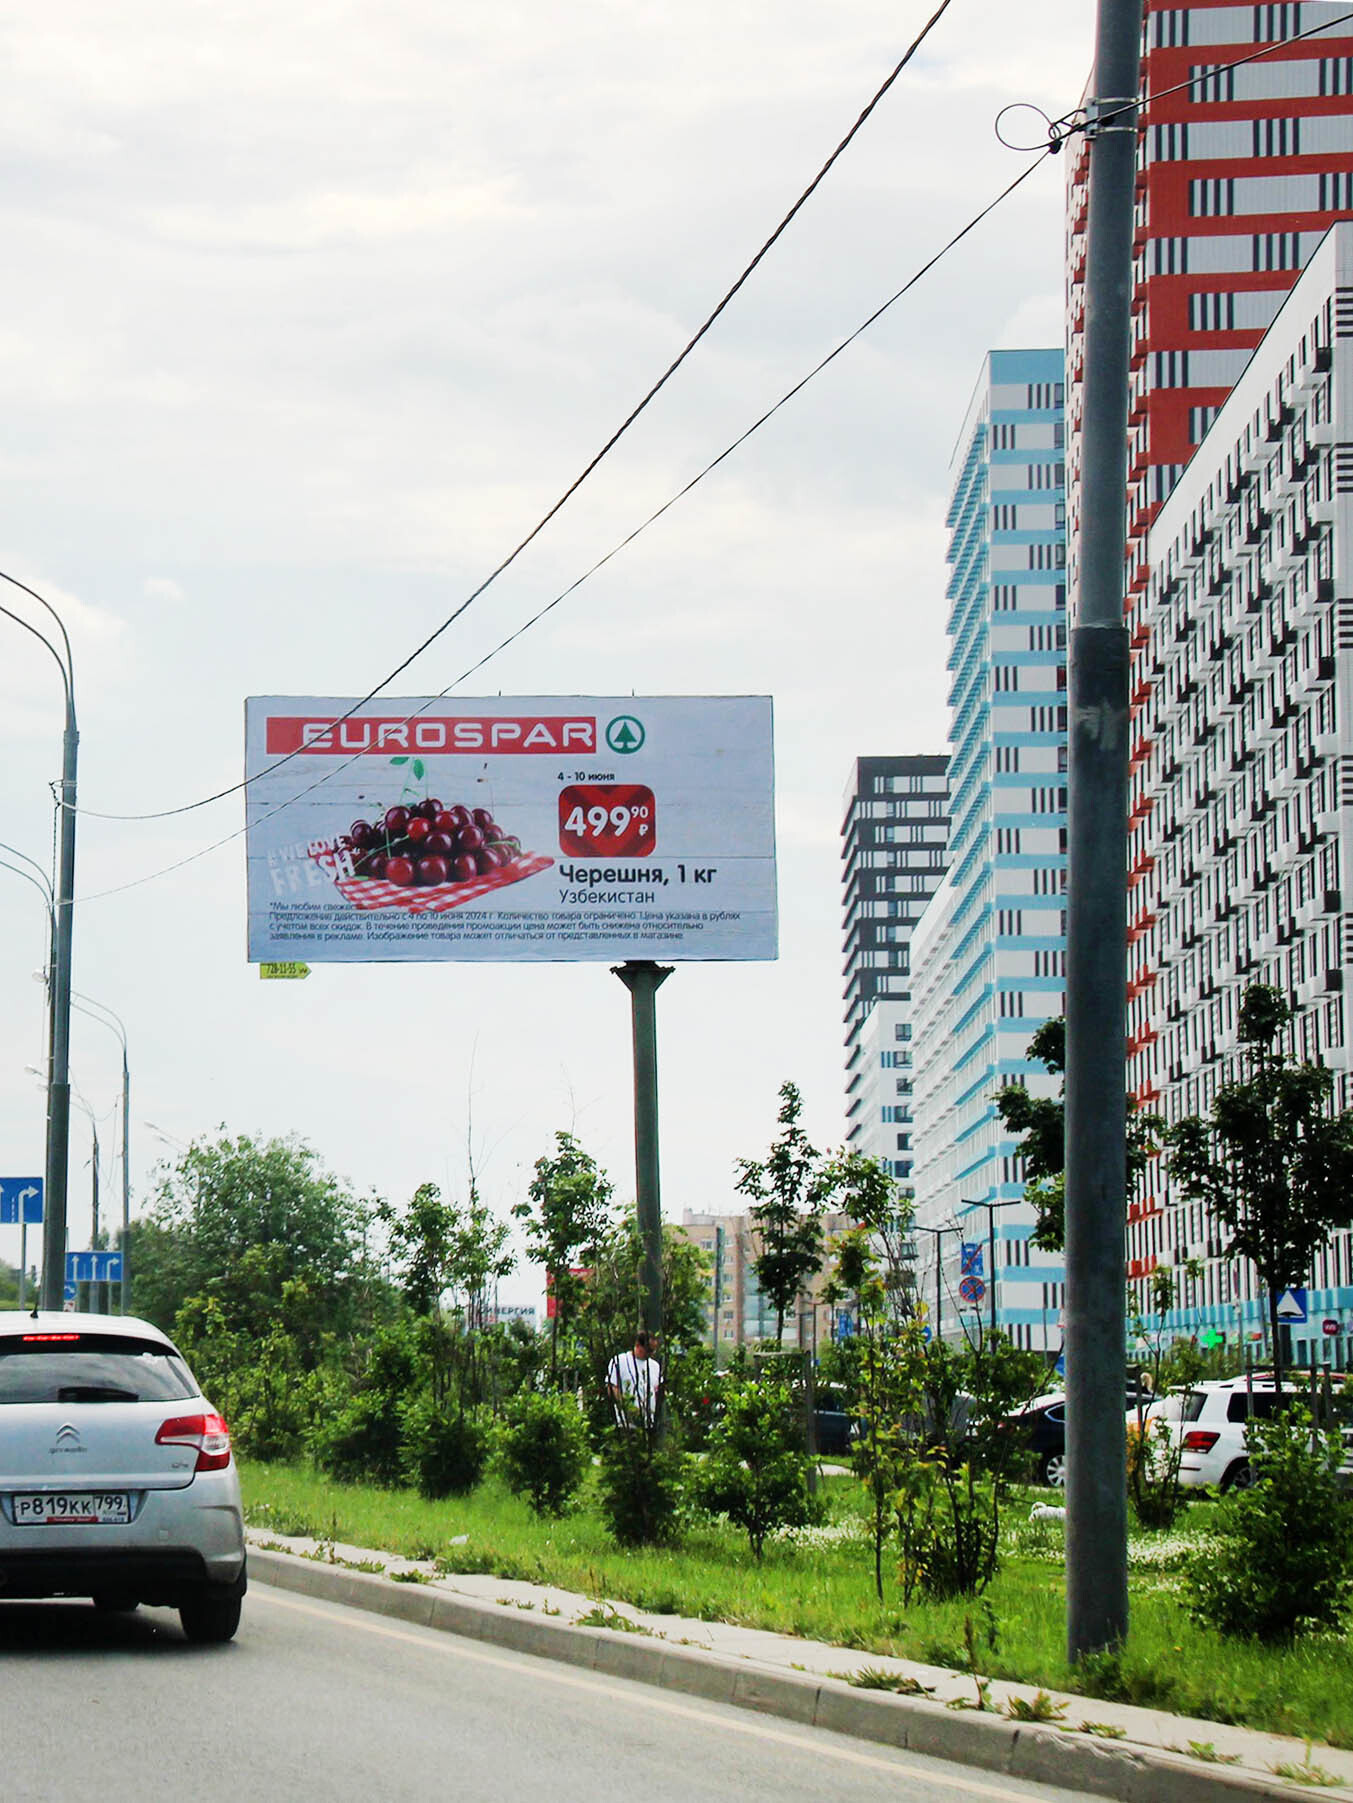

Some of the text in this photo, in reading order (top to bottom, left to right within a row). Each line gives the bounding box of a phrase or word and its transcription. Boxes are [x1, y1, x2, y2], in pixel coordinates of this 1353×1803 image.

[302, 722, 593, 748] EUROSPAR
[557, 771, 564, 781] 4
[574, 771, 586, 781] 10
[588, 773, 615, 781] июня
[564, 806, 649, 837] 499 90
[559, 864, 717, 888] Черешня, 1 кг
[559, 888, 655, 904] Узбекистан
[482, 1306, 535, 1315] ИНЕРГИЯ
[94, 1495, 123, 1510] 799
